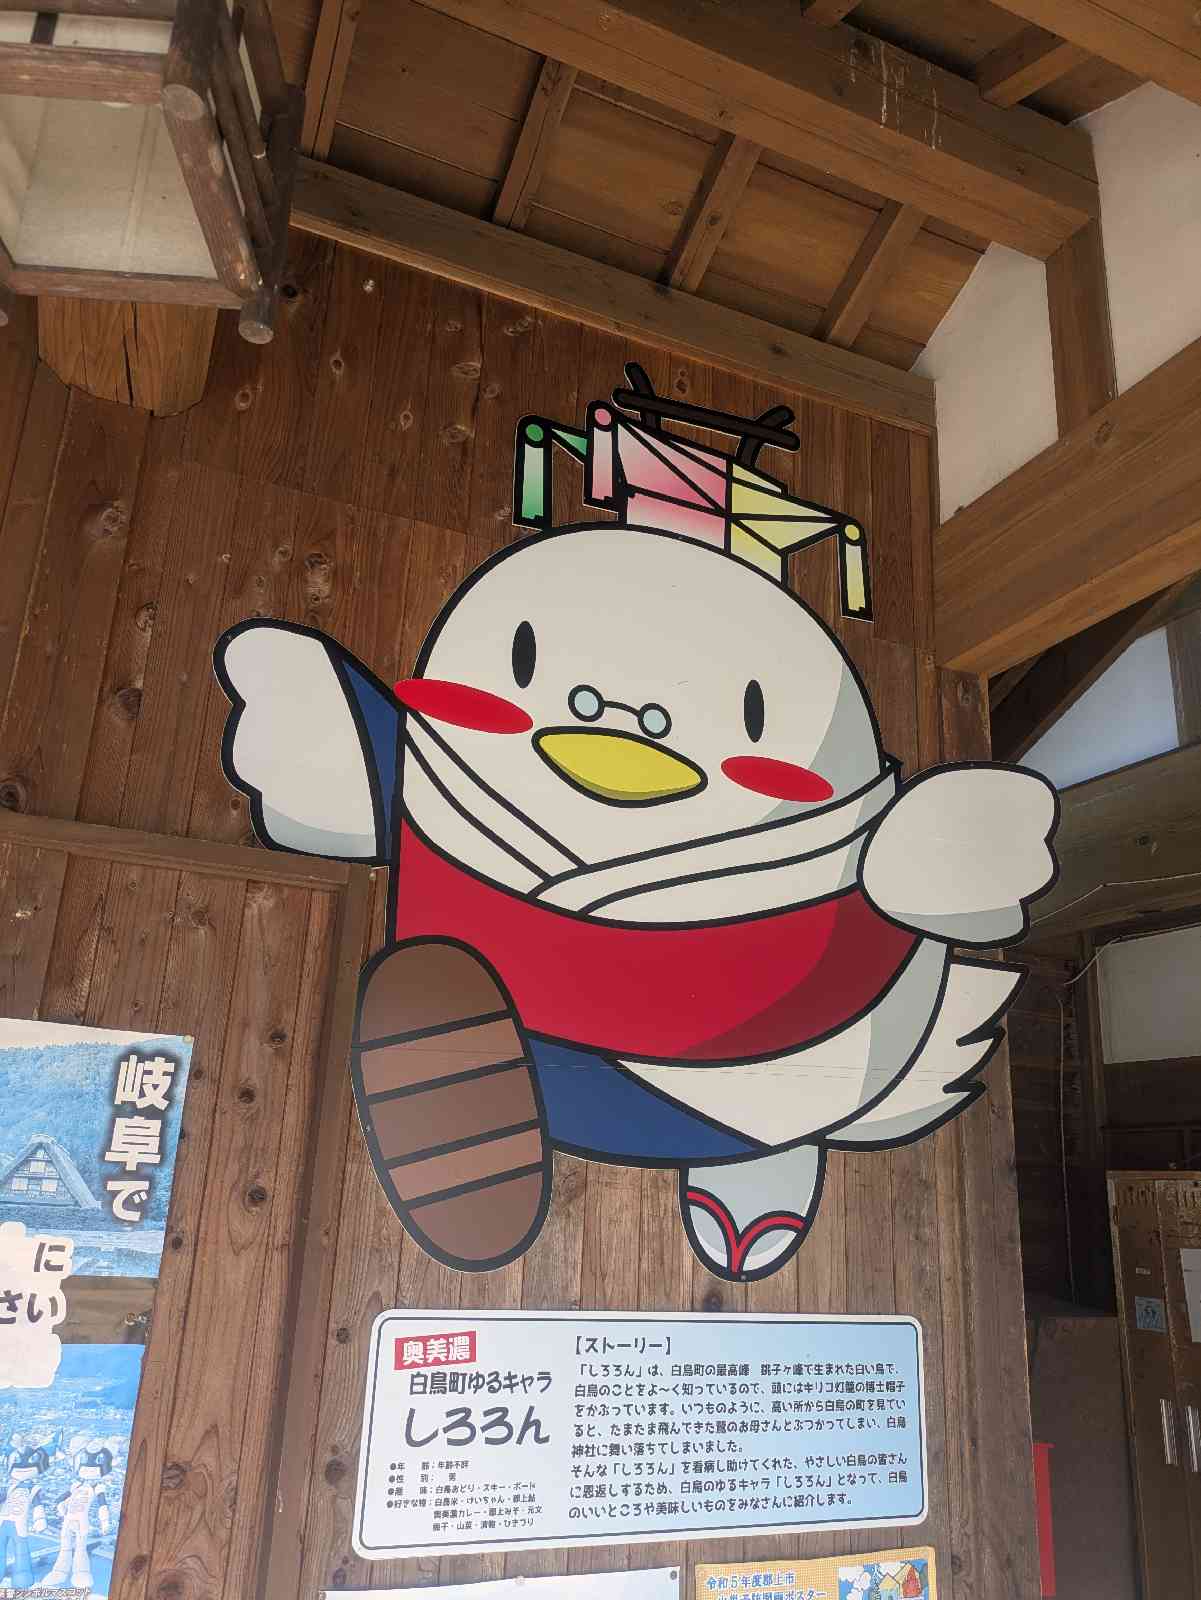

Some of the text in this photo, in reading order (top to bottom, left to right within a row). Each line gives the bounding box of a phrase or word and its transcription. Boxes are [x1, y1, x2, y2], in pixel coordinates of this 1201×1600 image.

[105, 1055, 175, 1222] 岐阜で
[34, 1243, 66, 1272] に
[402, 1336, 470, 1365] 奥美濃
[409, 1371, 552, 1394] 白鳥町ゆるキャラ
[404, 1406, 550, 1447] しろろん
